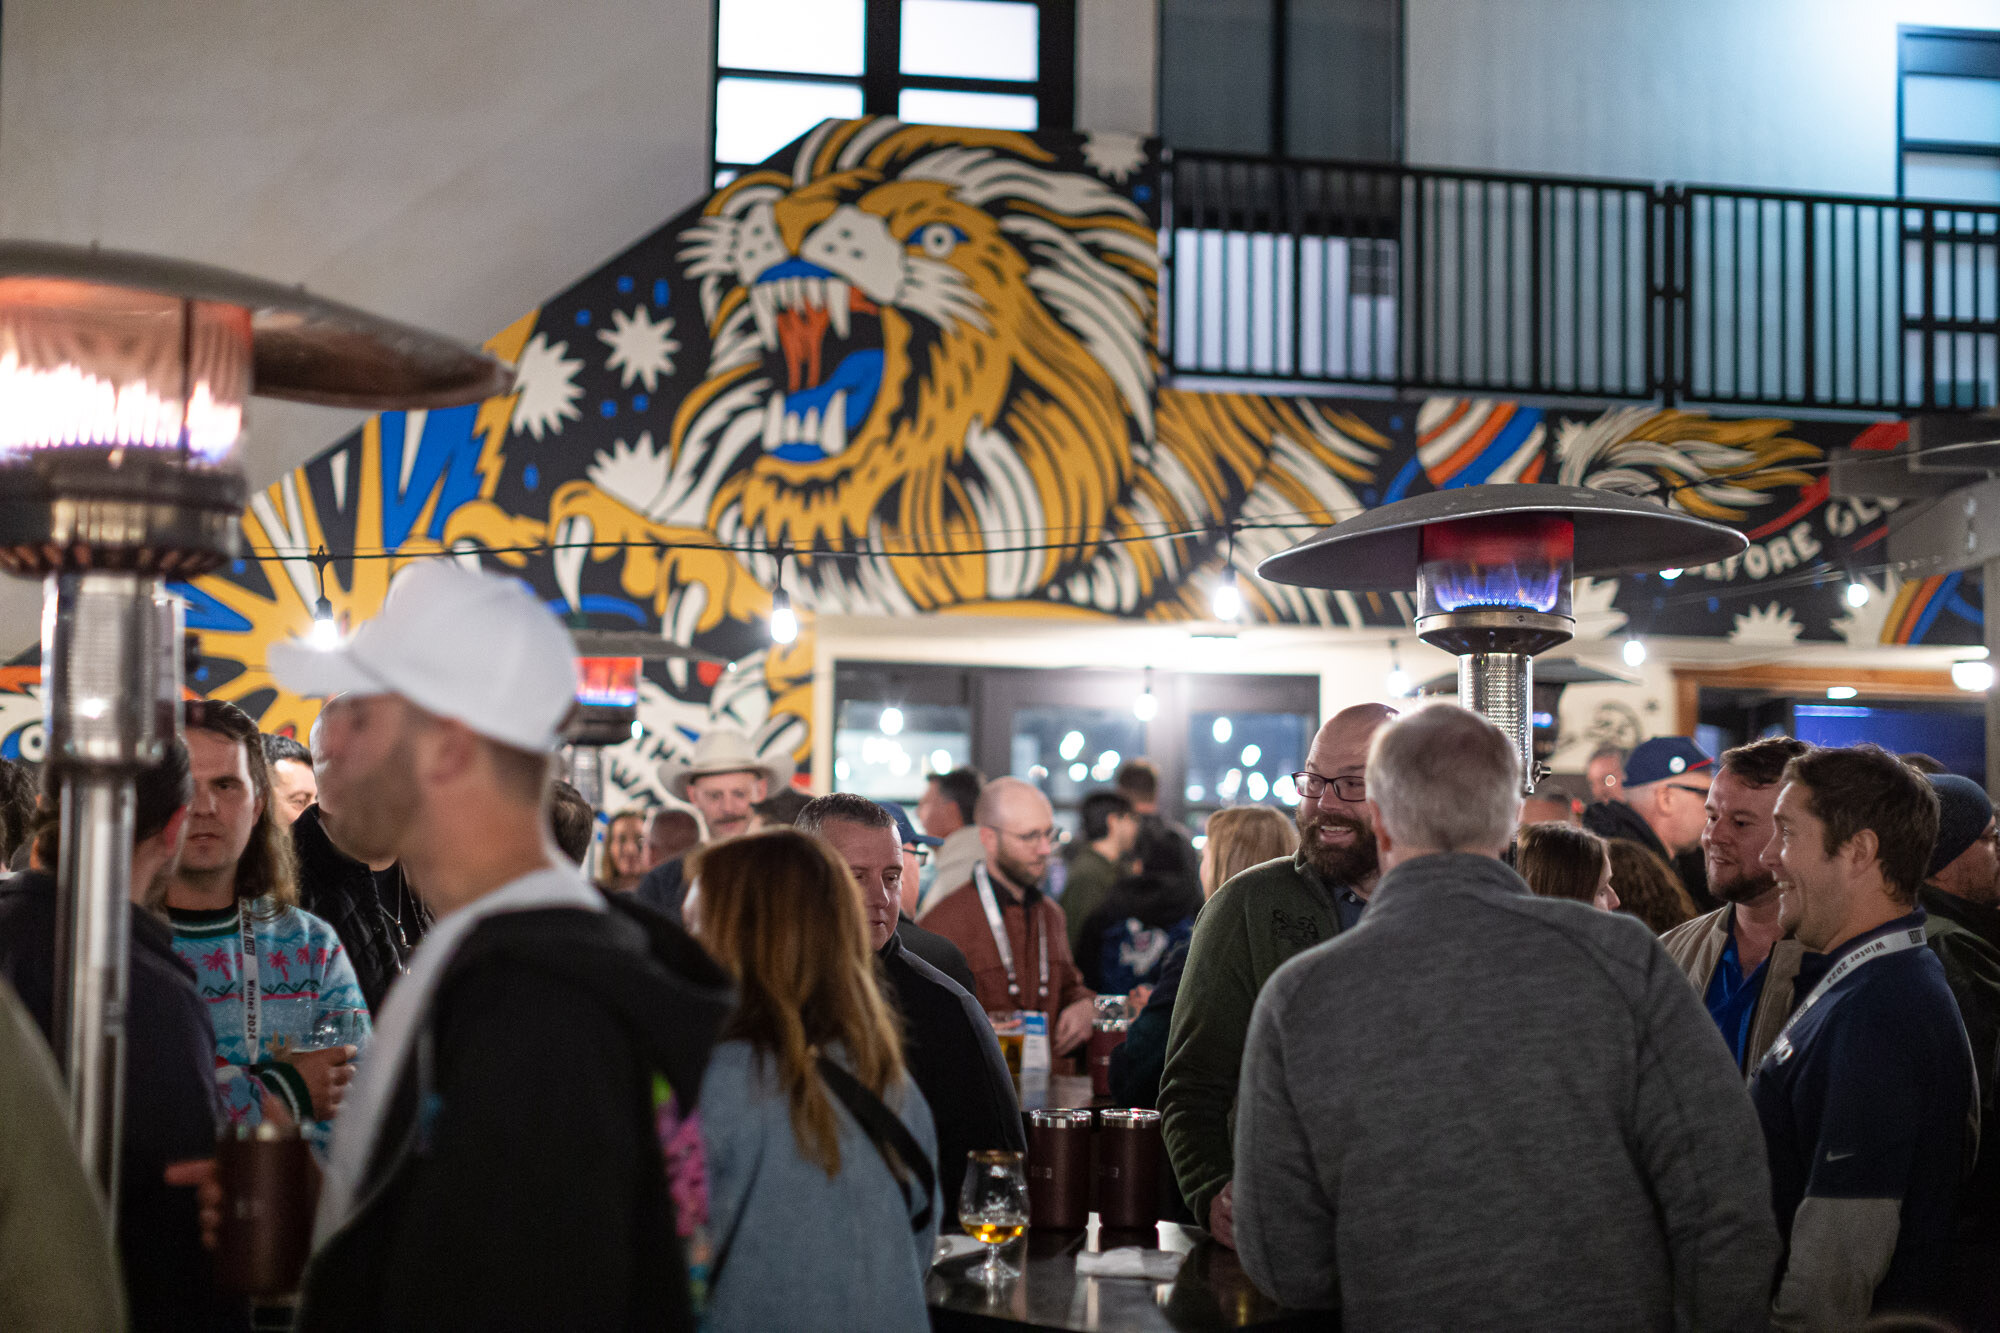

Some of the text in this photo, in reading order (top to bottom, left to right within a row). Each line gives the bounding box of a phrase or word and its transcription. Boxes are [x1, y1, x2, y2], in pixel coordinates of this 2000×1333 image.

[1850, 942, 1886, 962] Winter
[246, 980, 257, 1040] Winter 2024
